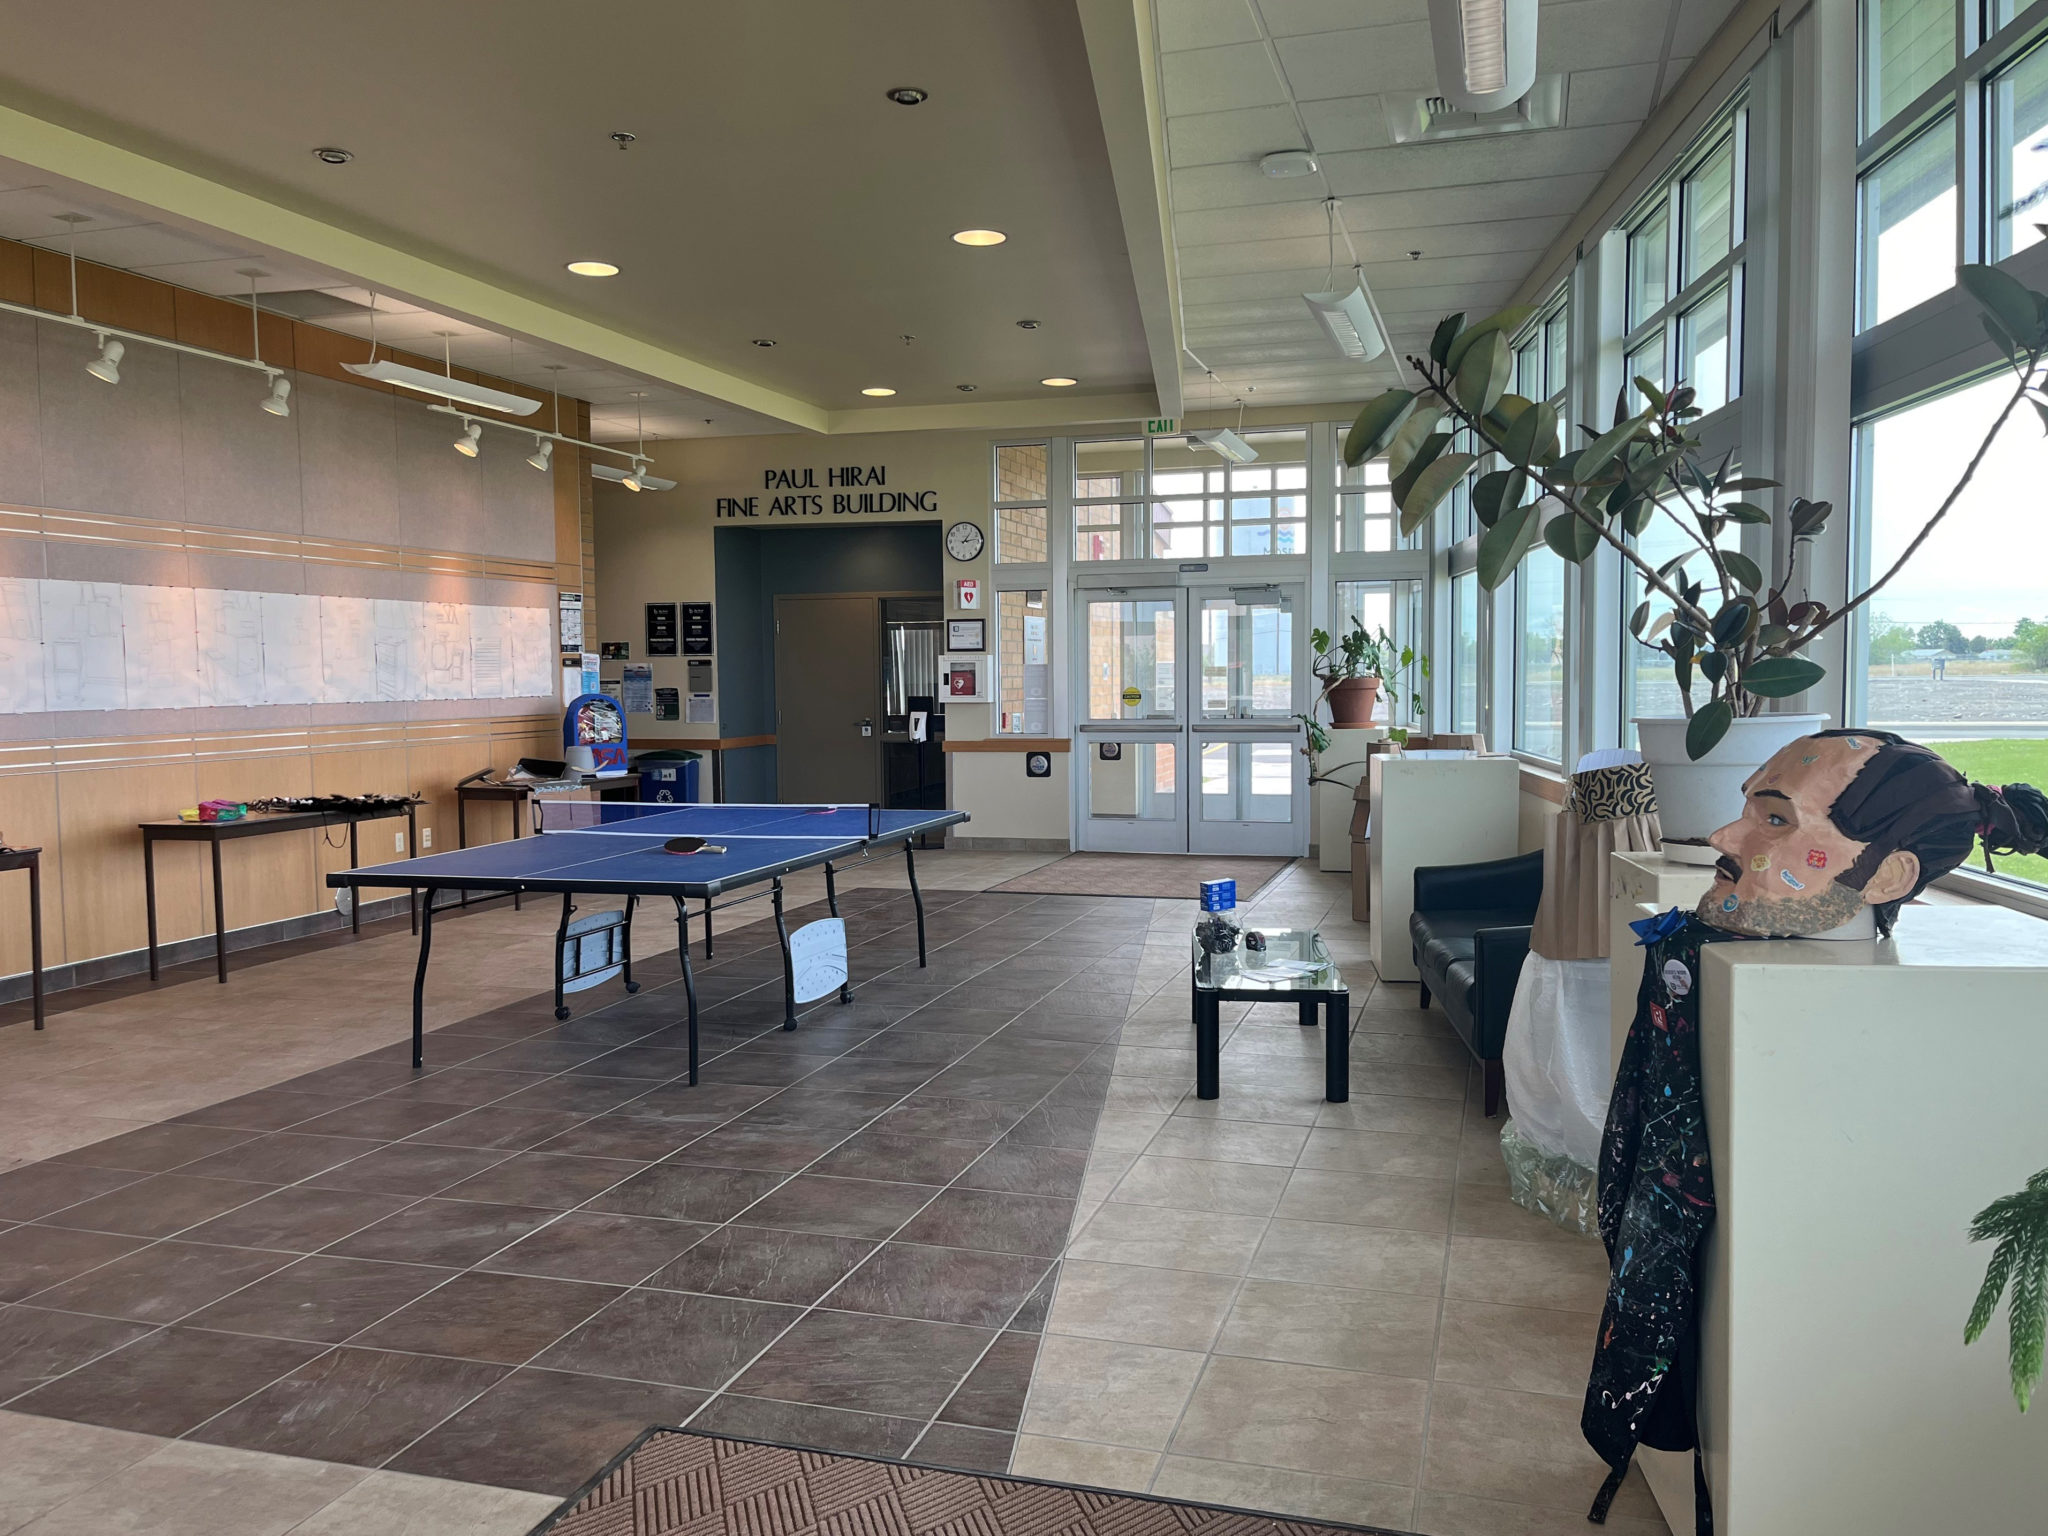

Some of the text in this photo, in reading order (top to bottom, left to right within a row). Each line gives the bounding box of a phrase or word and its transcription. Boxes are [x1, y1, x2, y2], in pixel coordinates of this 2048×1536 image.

[764, 465, 886, 489] PAUL HIRAI
[716, 490, 938, 518] FINE ARTS BUILDING
[592, 747, 627, 765] ASA
